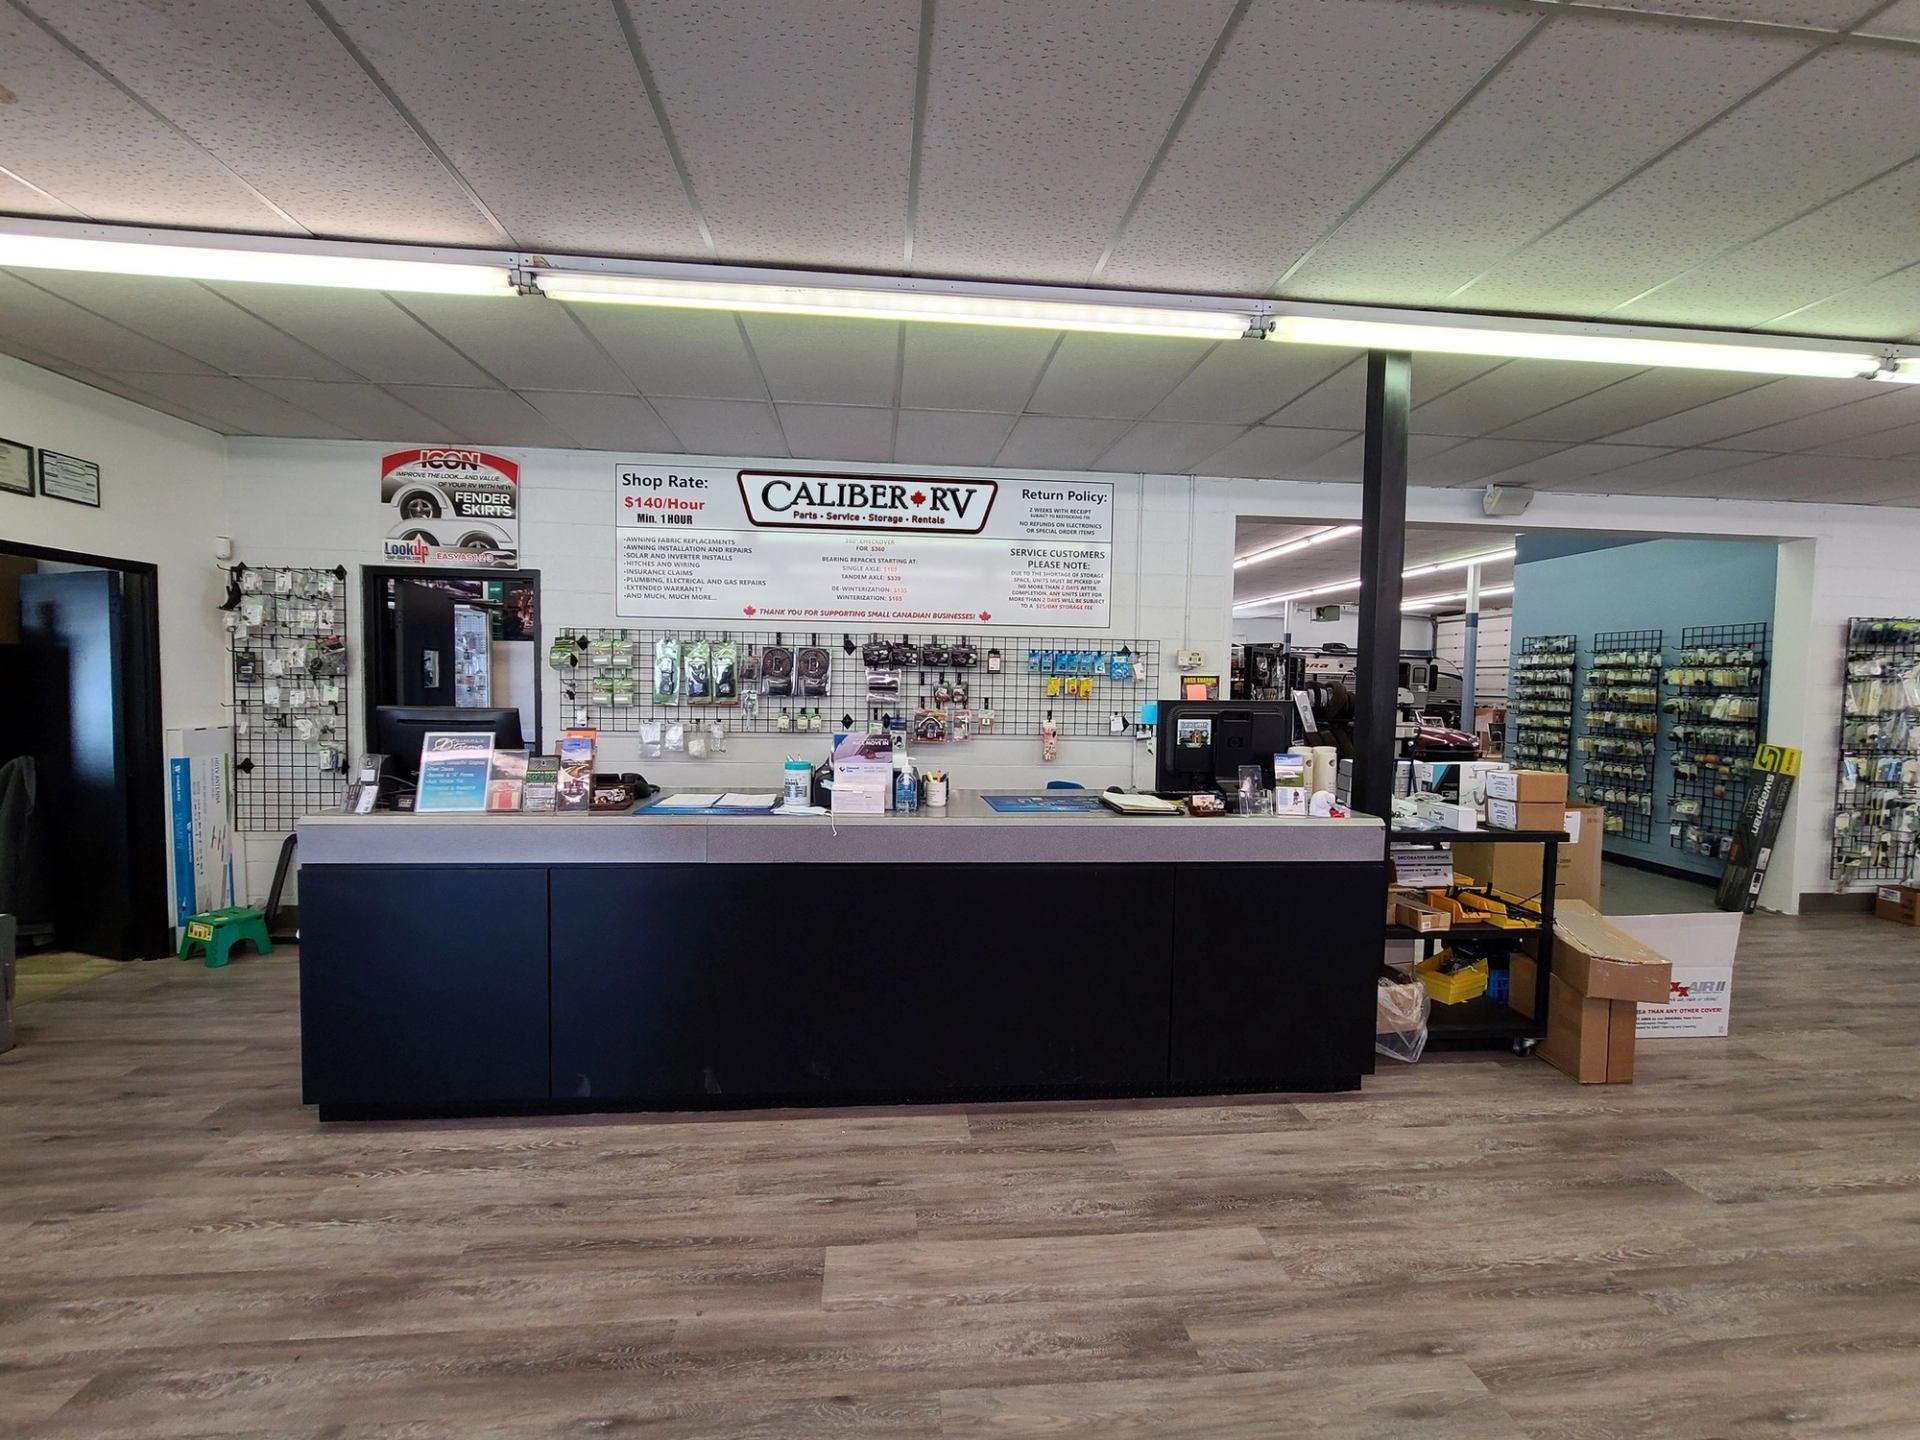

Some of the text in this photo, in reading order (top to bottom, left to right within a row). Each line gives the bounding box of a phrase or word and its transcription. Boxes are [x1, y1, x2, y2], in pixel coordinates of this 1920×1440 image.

[420, 450, 480, 471] ICON
[622, 473, 708, 490] Shop Rate:
[455, 491, 510, 504] FENDER
[624, 496, 706, 510] $140/Hour
[761, 480, 978, 519] CALIBER RV
[1022, 489, 1107, 505] Return Policy:
[462, 504, 512, 516] SKIRTS
[793, 510, 945, 524] Parts Service Storage Rentals
[637, 514, 693, 524] Min. 1 HOUR
[1010, 549, 1105, 559] SERVICE CUSTOMERS
[1751, 773, 1775, 834] swagman
